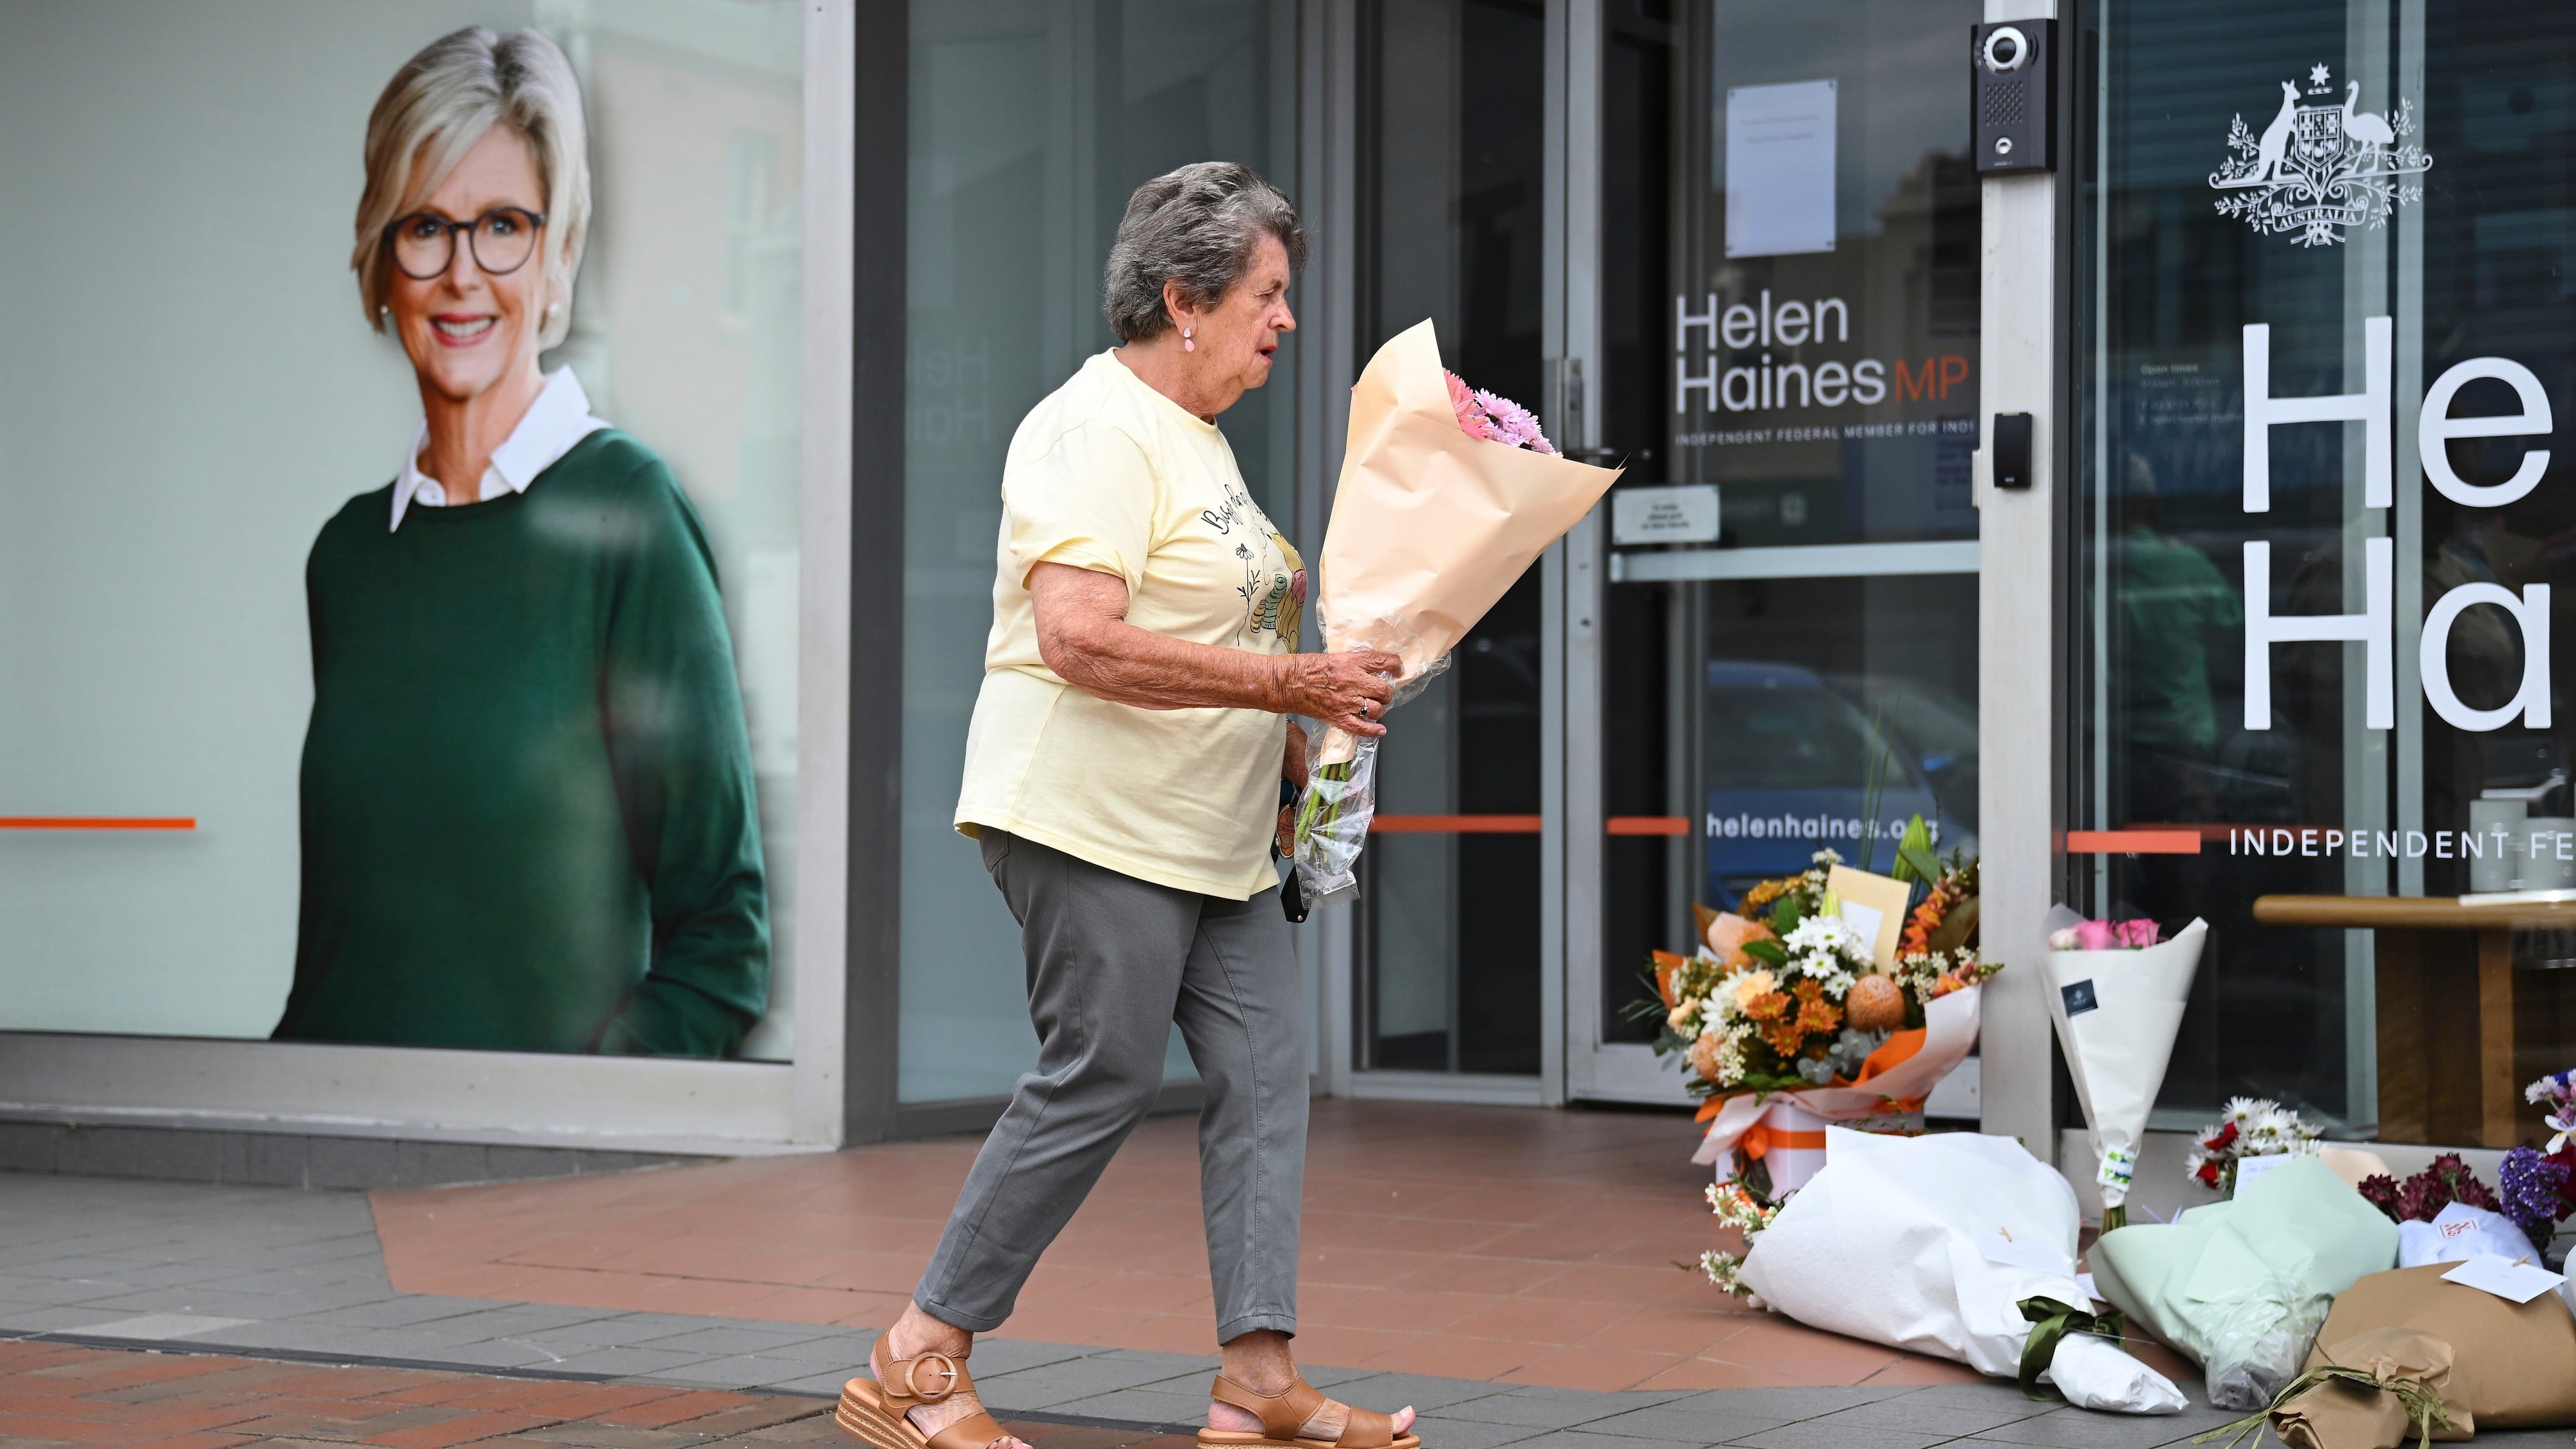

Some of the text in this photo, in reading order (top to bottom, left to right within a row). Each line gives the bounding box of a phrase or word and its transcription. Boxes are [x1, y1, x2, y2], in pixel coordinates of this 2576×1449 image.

[2279, 208, 2357, 228] AUSTRALIA
[1676, 289, 1848, 352] Helen
[1676, 354, 1970, 414] Haines MP
[1675, 419, 1976, 446] INDEPENDENT FEDERAL MEMBER FOR INDI
[1201, 500, 1244, 535] Busy
[1707, 812, 1939, 846] helenhaines.og
[2230, 829, 2575, 861] INDEPENDENT FE
